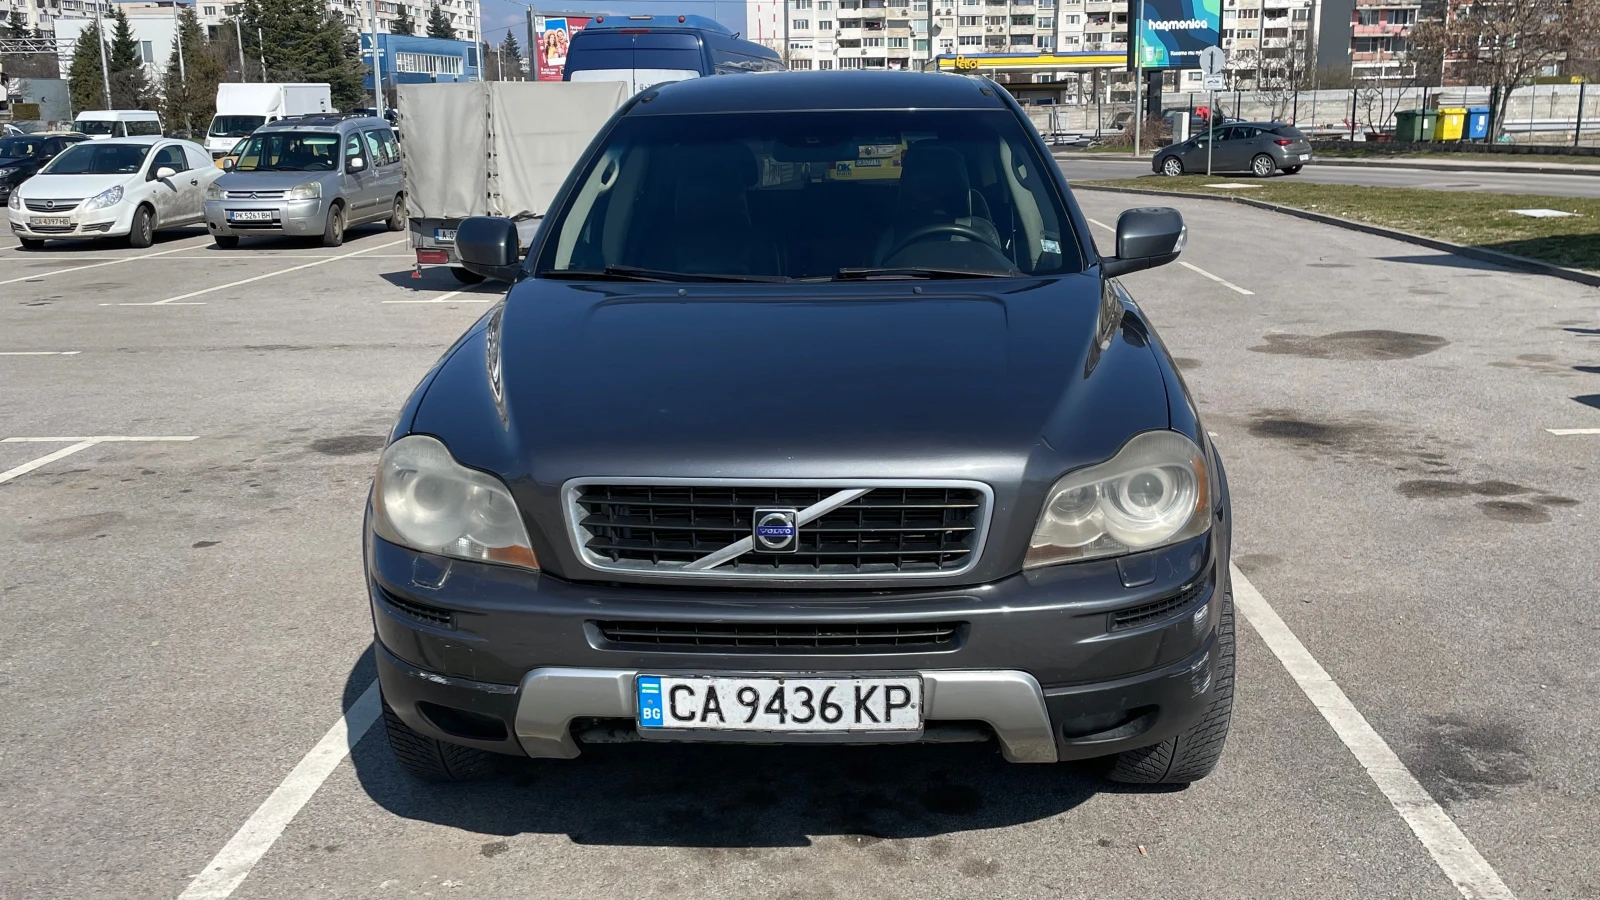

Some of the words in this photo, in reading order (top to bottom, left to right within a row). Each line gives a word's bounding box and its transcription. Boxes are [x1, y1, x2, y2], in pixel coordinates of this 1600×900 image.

[643, 707, 661, 720] BG
[668, 684, 726, 723] CA
[736, 685, 843, 724] 9436
[853, 684, 912, 724] KP
